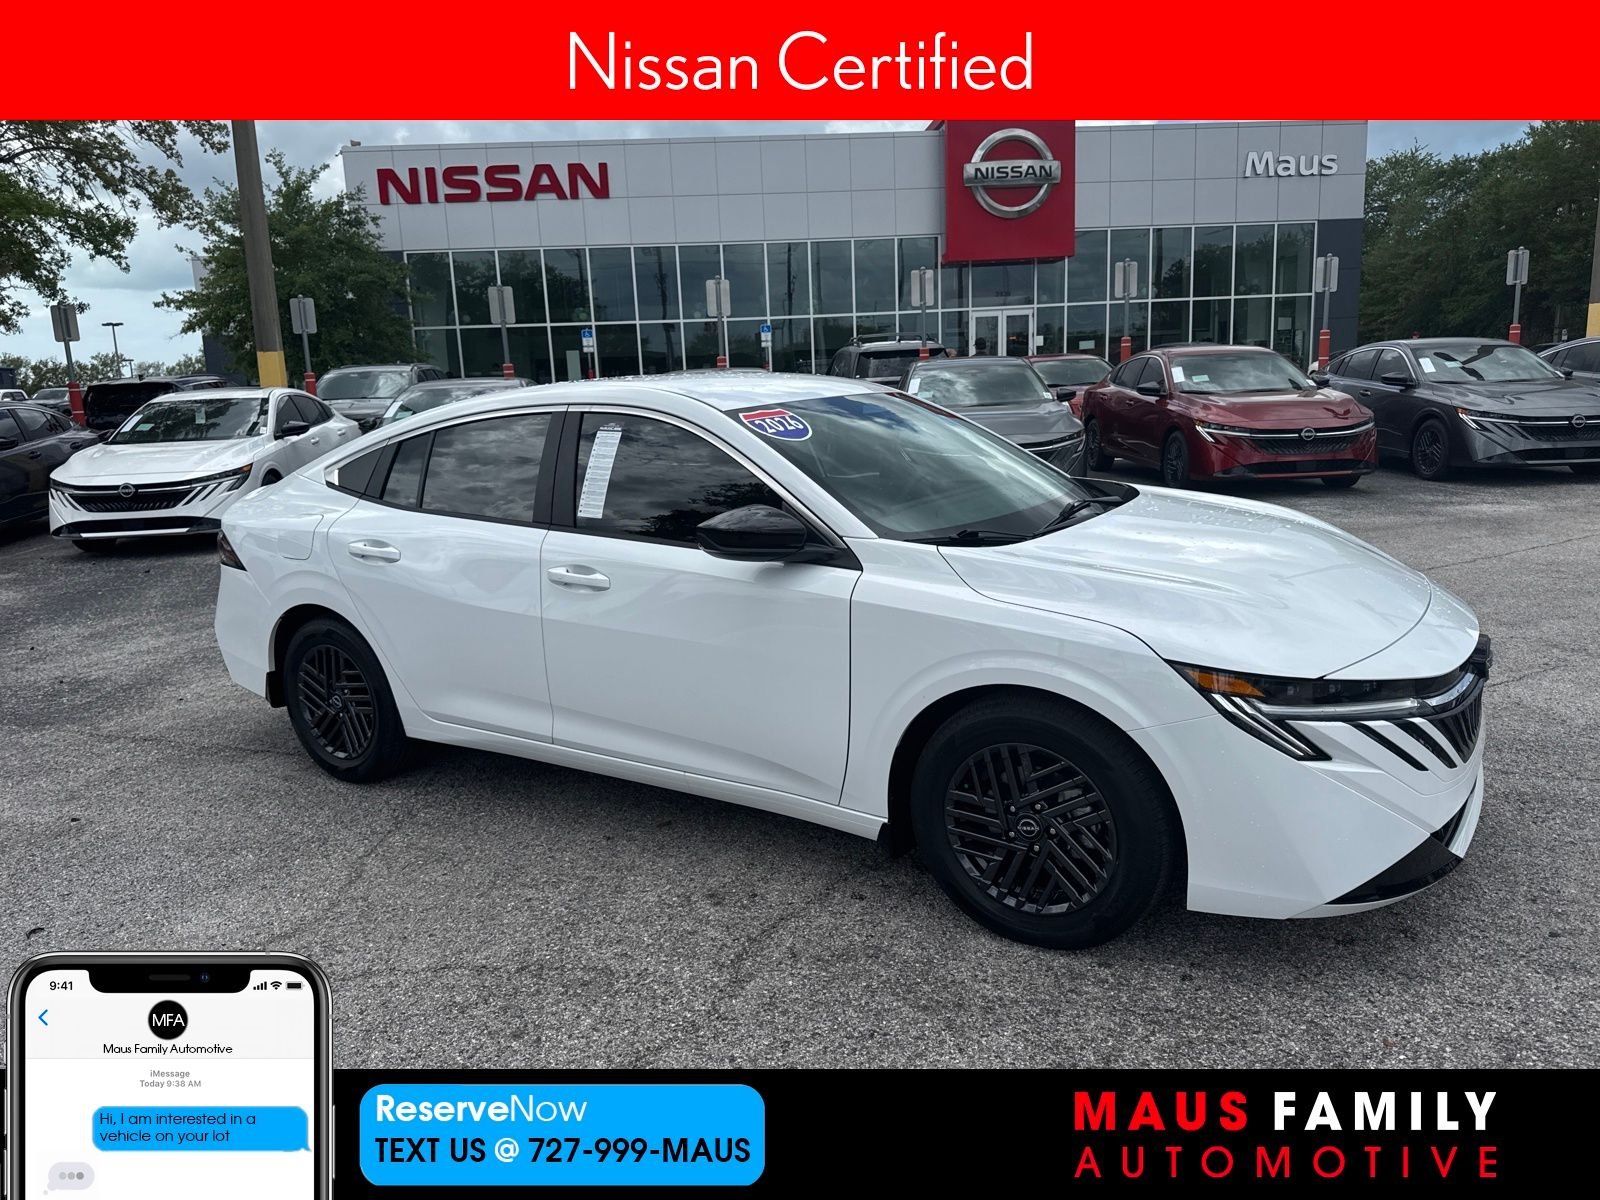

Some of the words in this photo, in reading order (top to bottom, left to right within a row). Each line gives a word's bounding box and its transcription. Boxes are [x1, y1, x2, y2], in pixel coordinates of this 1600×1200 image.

[974, 164, 1053, 181] NISSAN
[1245, 150, 1338, 177] Maus
[377, 162, 610, 205] NISSAN
[754, 415, 804, 433] 2026
